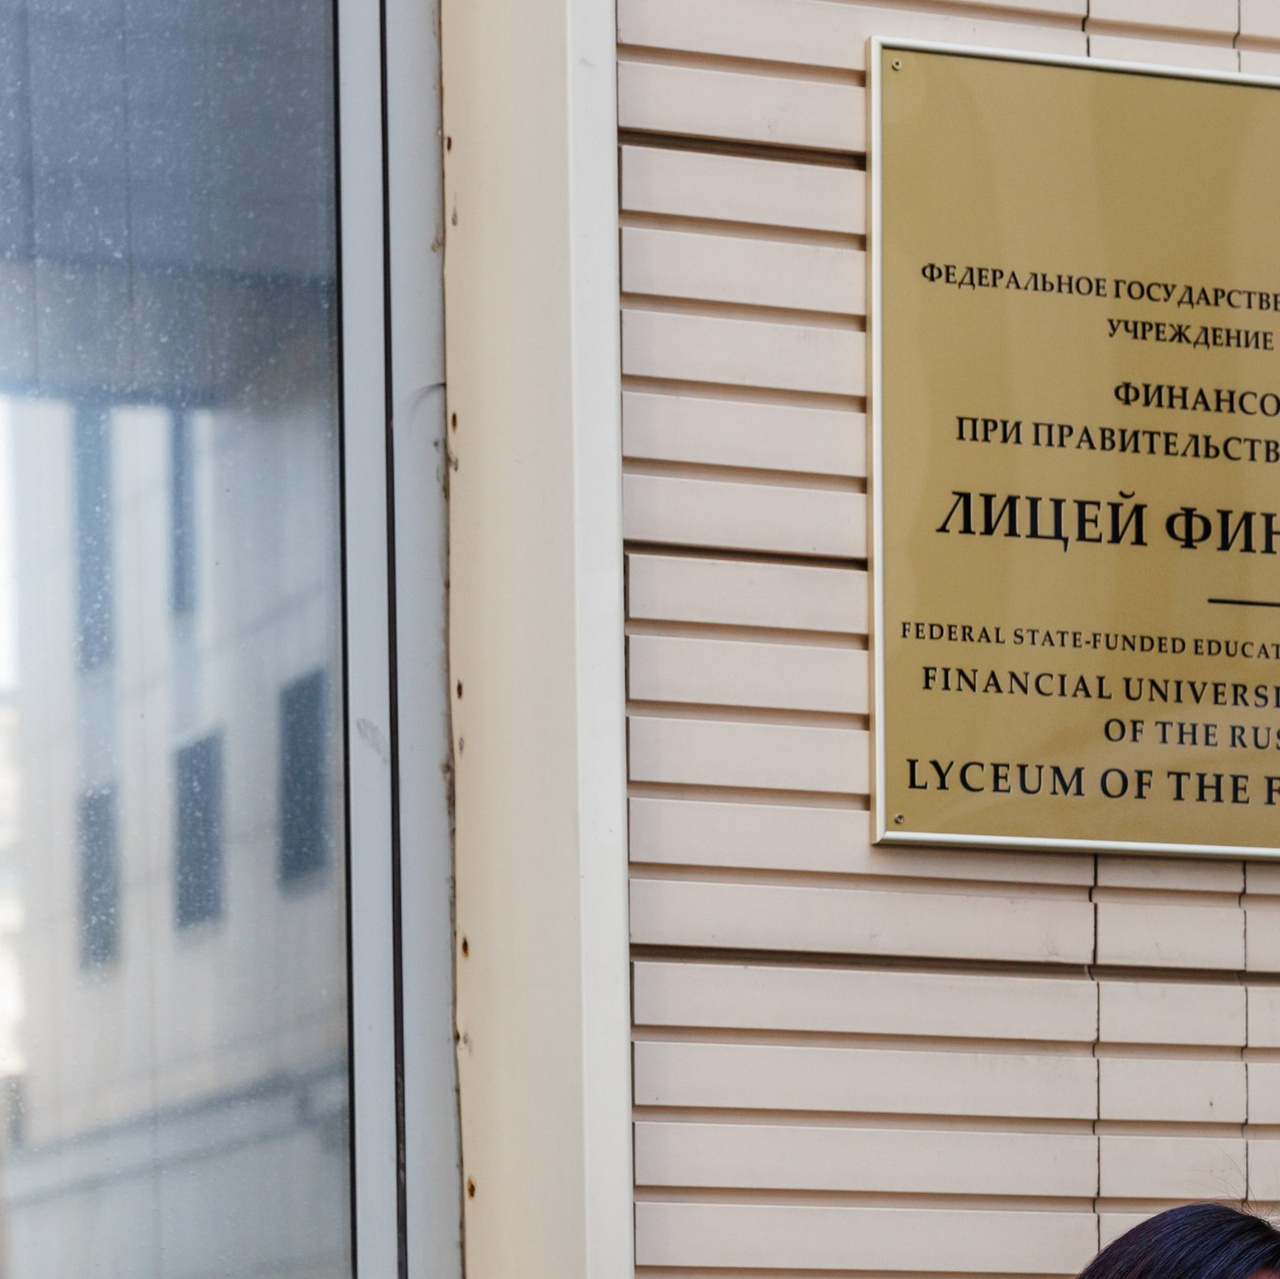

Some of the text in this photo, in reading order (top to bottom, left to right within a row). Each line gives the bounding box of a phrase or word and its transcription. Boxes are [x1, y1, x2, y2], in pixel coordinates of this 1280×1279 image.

[920, 262, 1108, 298] ФЕДЕРАЛЬНОЕ
[1106, 318, 1275, 351] УЧРЕЖДЕНИЕ
[955, 415, 1023, 446] ПРИ
[934, 490, 1148, 554] ЛИЦЕЙ
[901, 621, 1006, 645] FEDERAL
[1013, 627, 1187, 655] STATE-FUNDED
[921, 665, 1113, 700] FINANCIAL
[1103, 717, 1145, 743] OF
[1154, 720, 1218, 747] THE
[905, 758, 1085, 797] LYCEUM
[1100, 767, 1153, 800] OF
[1166, 770, 1250, 805] THE
